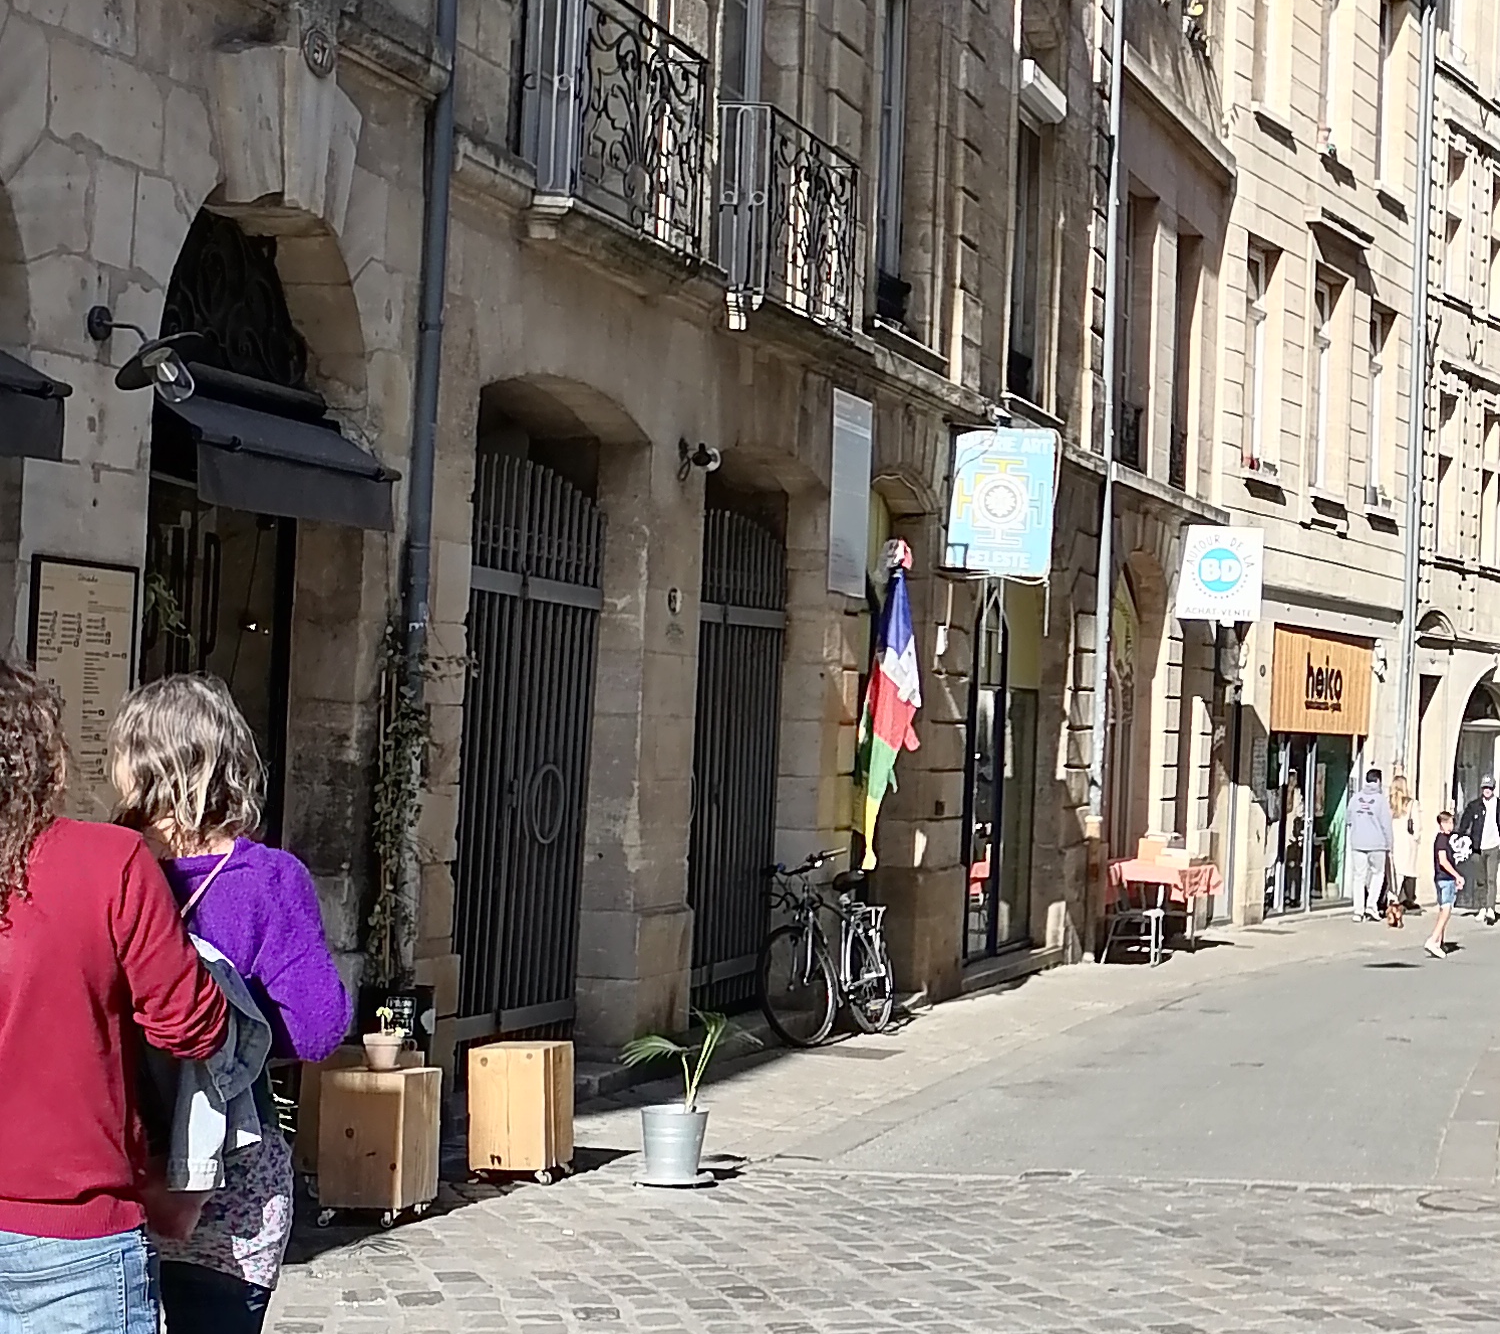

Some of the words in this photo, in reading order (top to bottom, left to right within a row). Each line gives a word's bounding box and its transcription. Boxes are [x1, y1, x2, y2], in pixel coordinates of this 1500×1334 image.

[1021, 437, 1051, 455] ART
[967, 549, 1031, 569] CELESTE
[1186, 534, 1220, 566] AUTOUR
[1230, 537, 1244, 551] DE
[1242, 554, 1255, 569] LA
[1200, 557, 1242, 582] BD
